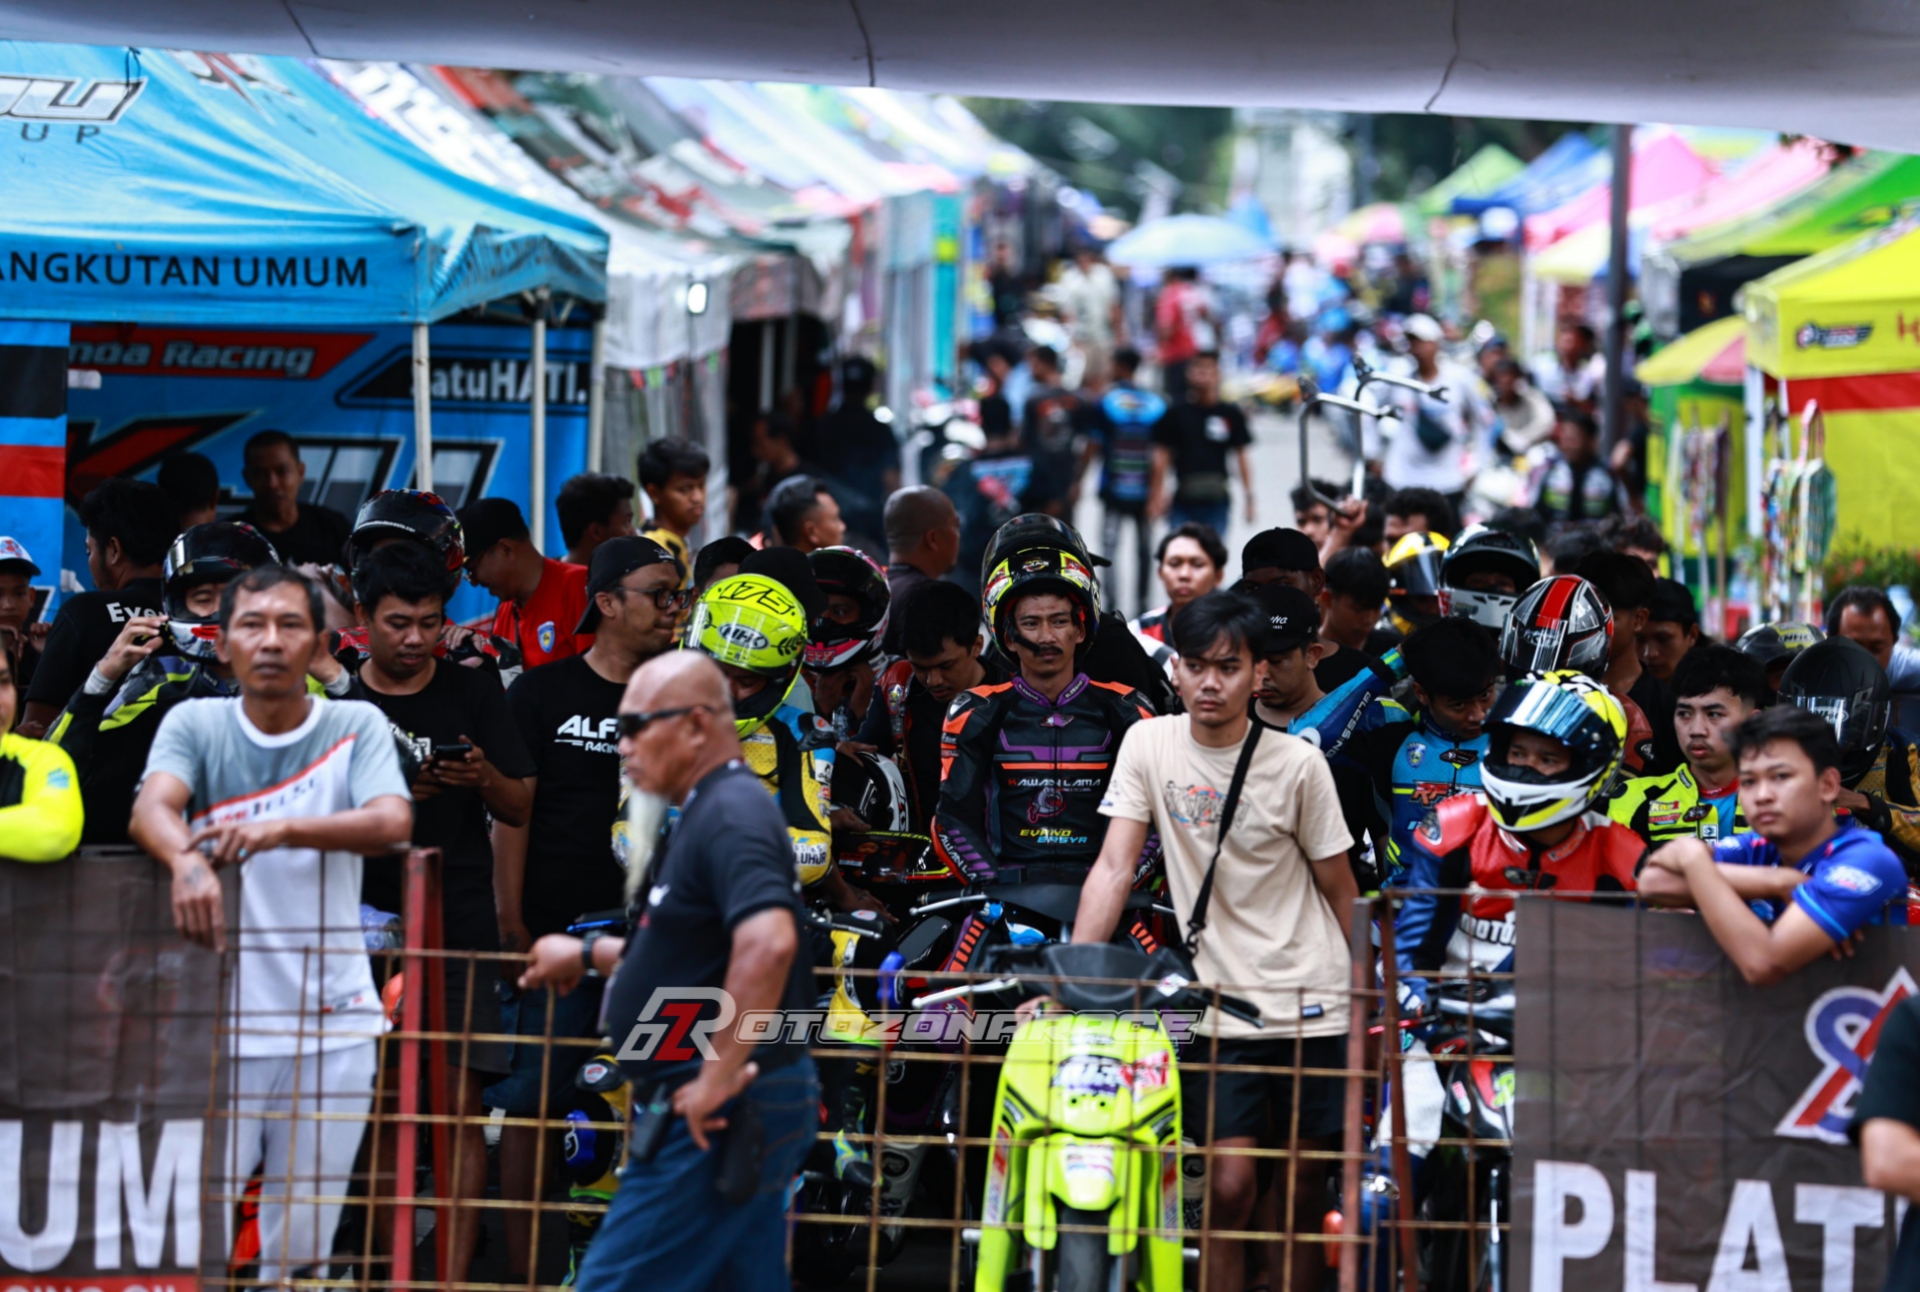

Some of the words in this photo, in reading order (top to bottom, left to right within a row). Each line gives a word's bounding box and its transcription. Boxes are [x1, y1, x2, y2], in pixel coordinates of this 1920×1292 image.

[0, 251, 219, 286] NGKUTAN
[233, 256, 368, 287] UMUM
[162, 340, 316, 377] Racing
[557, 714, 620, 739] ALF
[1063, 778, 1101, 787] LAMA
